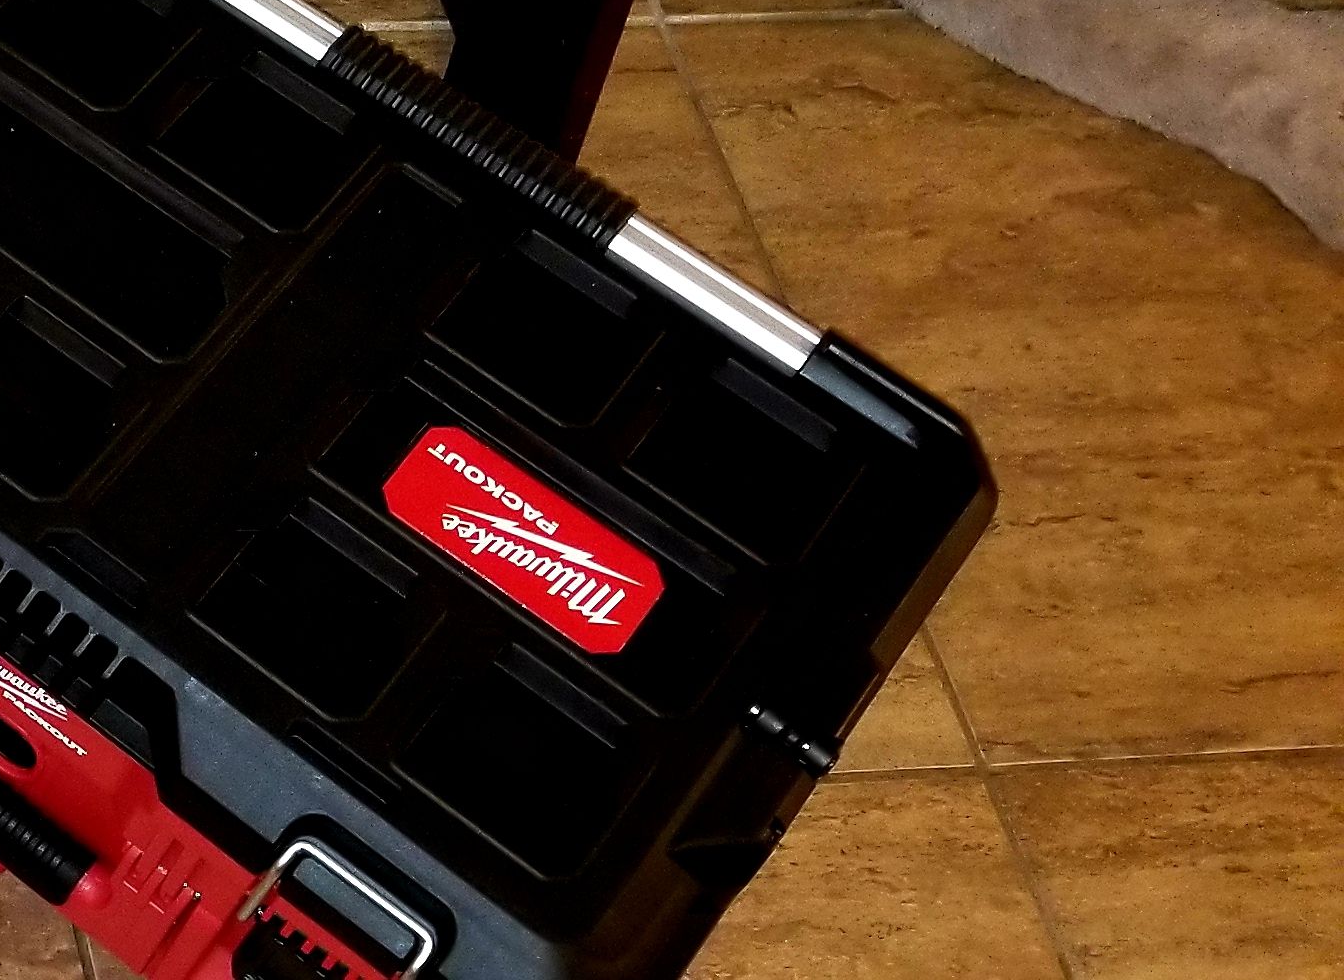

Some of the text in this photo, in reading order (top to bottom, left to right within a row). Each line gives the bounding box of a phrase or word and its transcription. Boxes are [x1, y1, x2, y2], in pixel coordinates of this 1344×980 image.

[427, 443, 560, 536] PACKOUT
[441, 513, 626, 626] Milwaukee
[2, 690, 88, 756] PACKOUT
